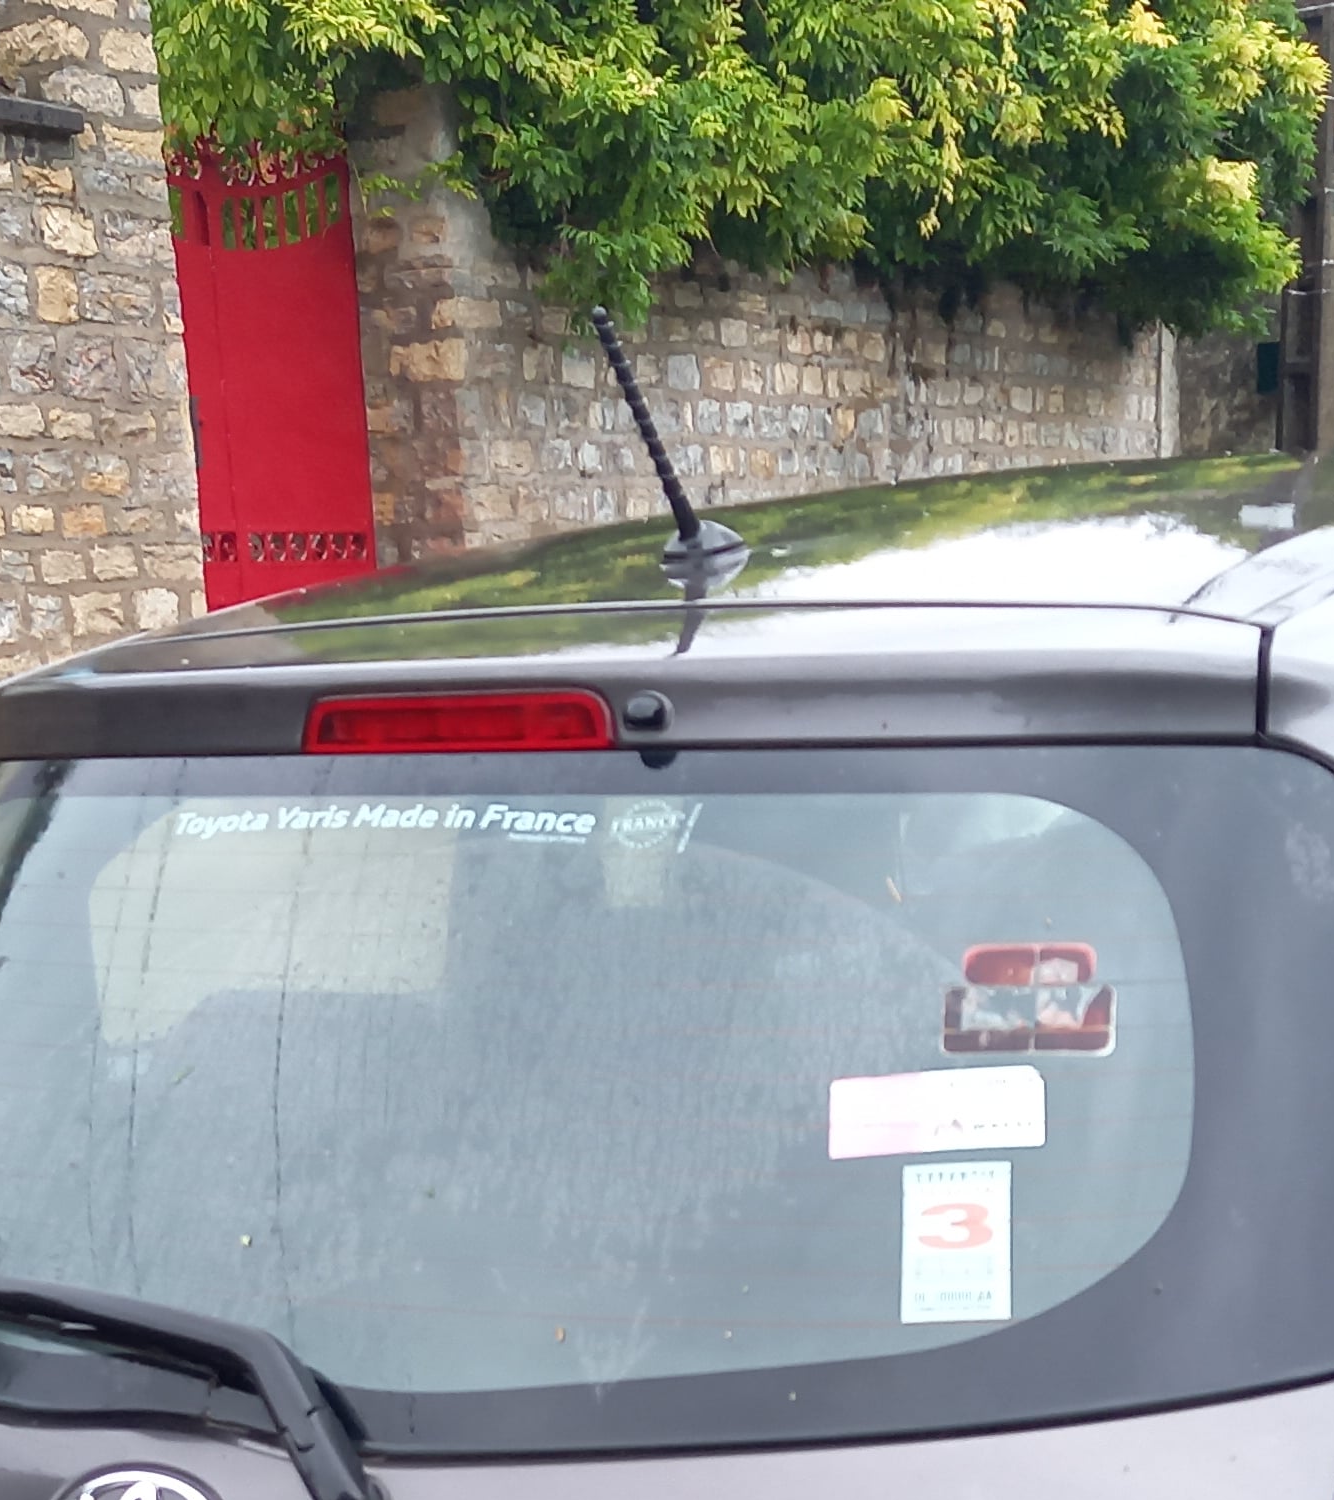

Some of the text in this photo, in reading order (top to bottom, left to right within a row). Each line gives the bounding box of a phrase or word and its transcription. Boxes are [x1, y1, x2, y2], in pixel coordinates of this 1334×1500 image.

[175, 803, 597, 840] Toyota Yaris Made in France
[918, 1203, 994, 1249] 3
